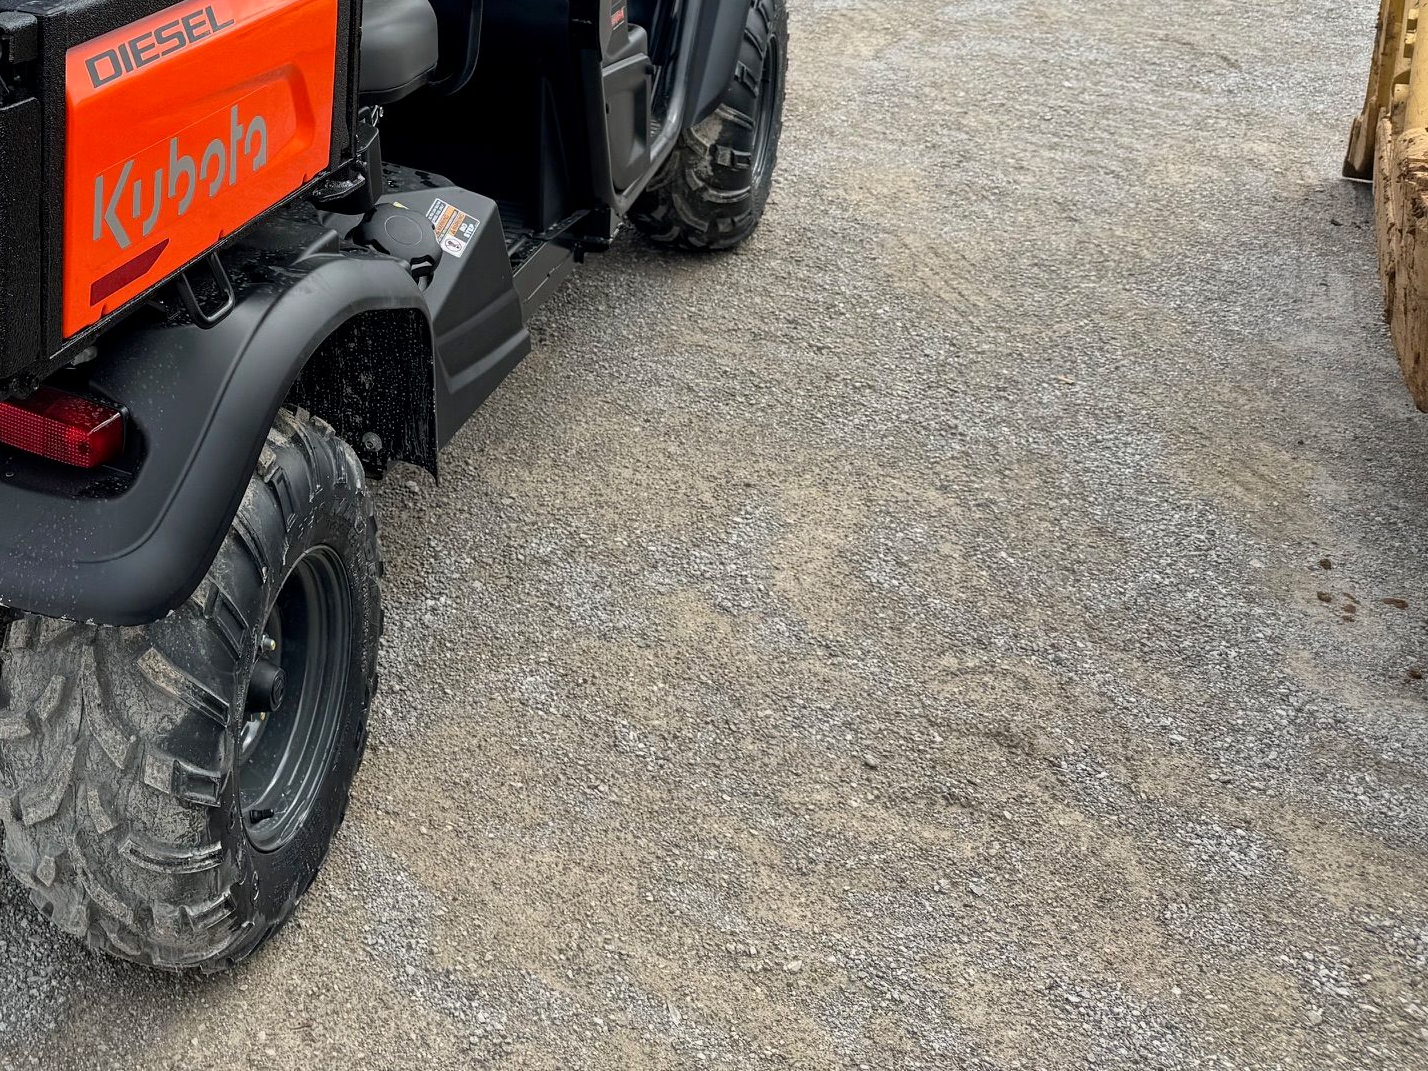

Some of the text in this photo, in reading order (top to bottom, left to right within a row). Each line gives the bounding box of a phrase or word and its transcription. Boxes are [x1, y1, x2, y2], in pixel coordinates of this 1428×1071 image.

[84, 5, 235, 89] DIESEL
[92, 103, 268, 250] Kubota
[459, 223, 468, 233] NO
[463, 223, 475, 238] STEP
